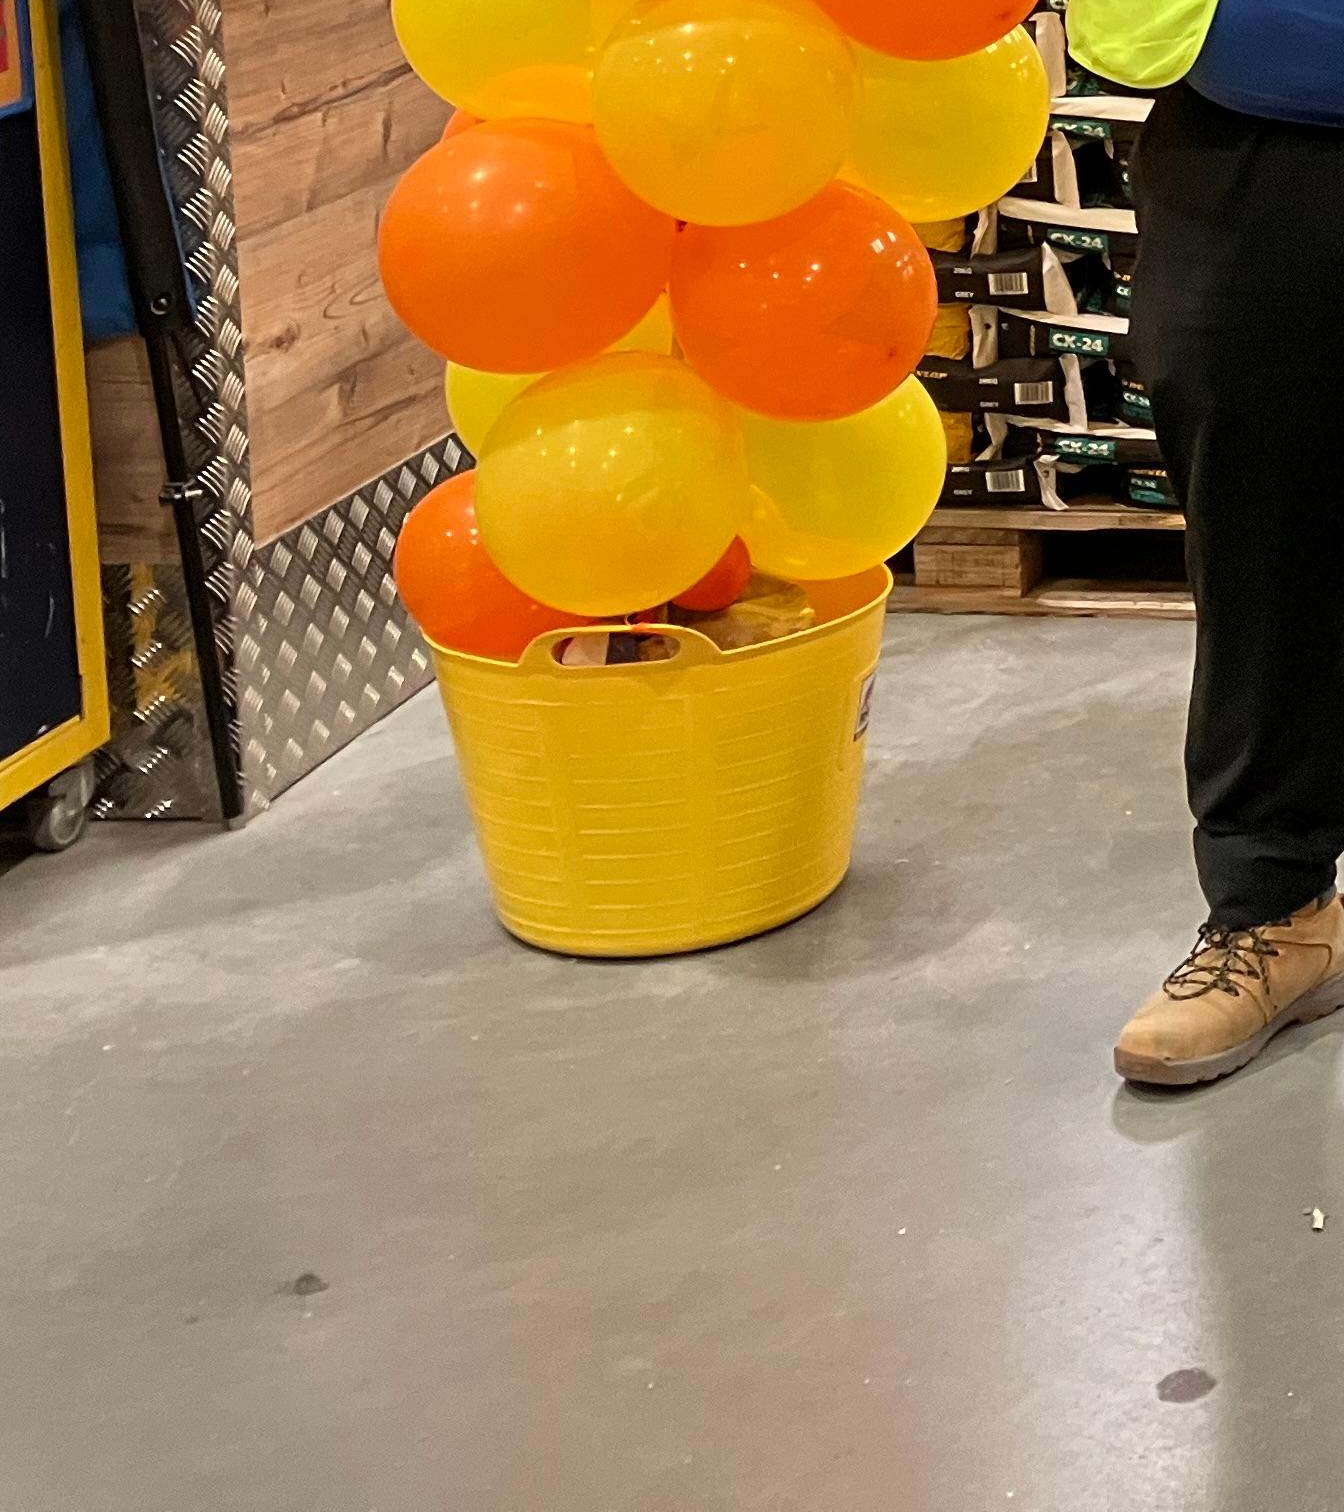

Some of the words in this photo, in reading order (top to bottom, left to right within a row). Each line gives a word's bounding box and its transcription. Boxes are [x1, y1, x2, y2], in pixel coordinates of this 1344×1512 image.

[1050, 232, 1103, 249] CX-24
[1052, 333, 1104, 352] CX-24
[1058, 440, 1110, 456] CX-24
